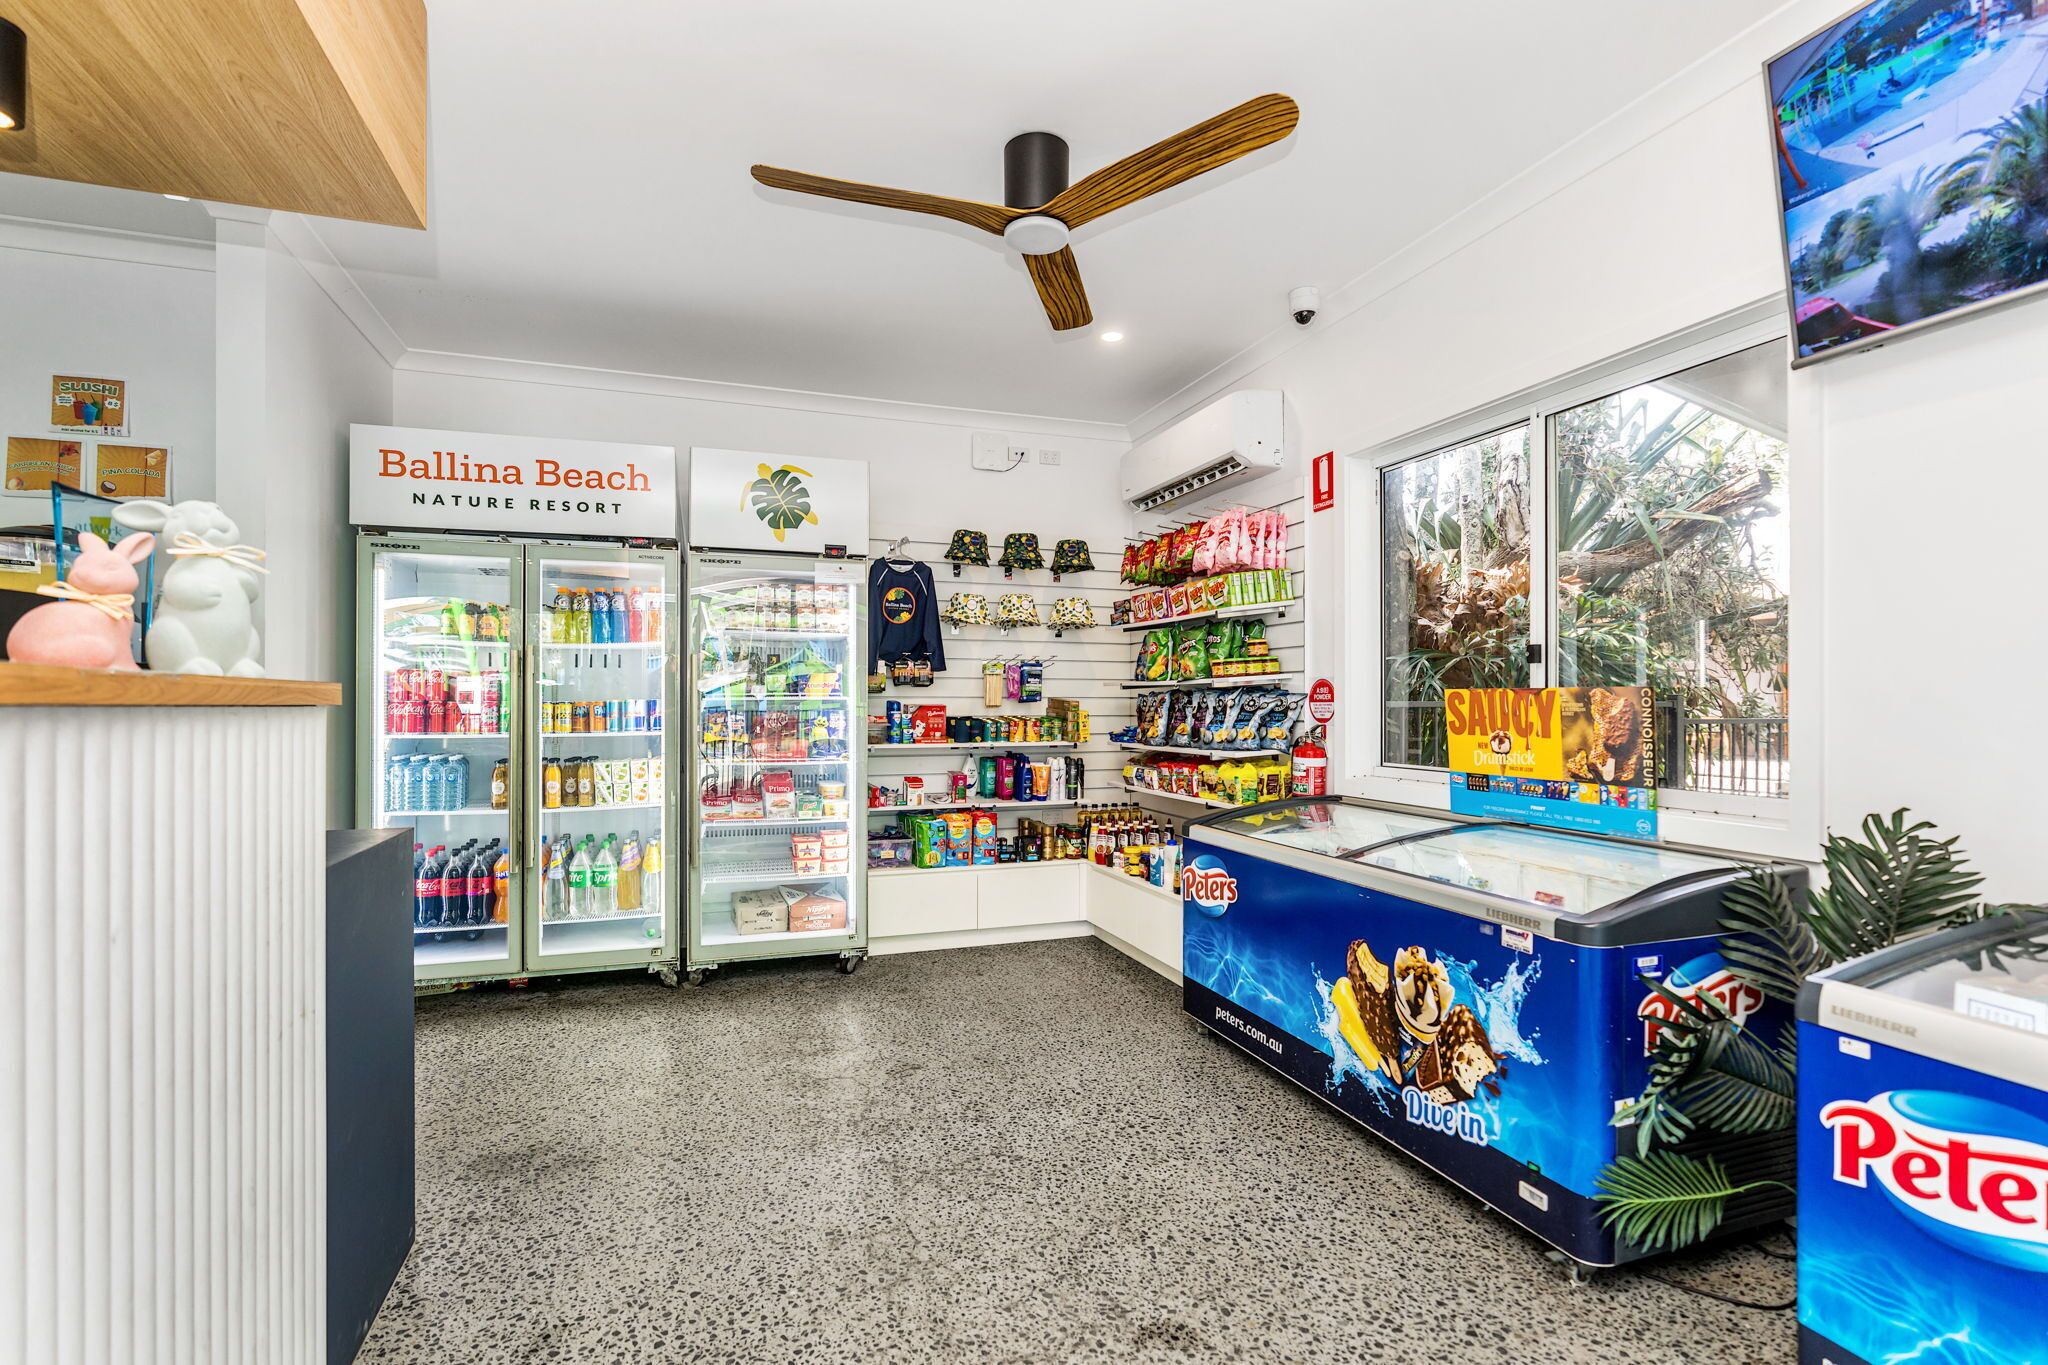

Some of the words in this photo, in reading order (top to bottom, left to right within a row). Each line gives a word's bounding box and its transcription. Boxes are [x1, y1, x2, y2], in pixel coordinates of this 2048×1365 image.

[60, 382, 118, 396] SLUSHI
[124, 467, 161, 478] COLADA
[378, 448, 524, 486] Ballina
[535, 459, 652, 492] Beach
[412, 492, 515, 510] NATURE
[529, 499, 623, 515] RESORT
[573, 705, 588, 716] FAN
[1448, 688, 1557, 739] SAUCY
[1640, 687, 1654, 787] CONNOISSEUR
[1473, 750, 1536, 766] Drumstick
[768, 785, 791, 793] Primo
[1183, 866, 1237, 901] Peters
[1486, 907, 1541, 929] LIEBHERR
[1215, 1006, 1283, 1055] peters.com.au
[1831, 1005, 1918, 1038] LIEBHERR
[1405, 1088, 1455, 1132] Dive
[1460, 1104, 1485, 1142] in
[1826, 1105, 2048, 1230] Pete
